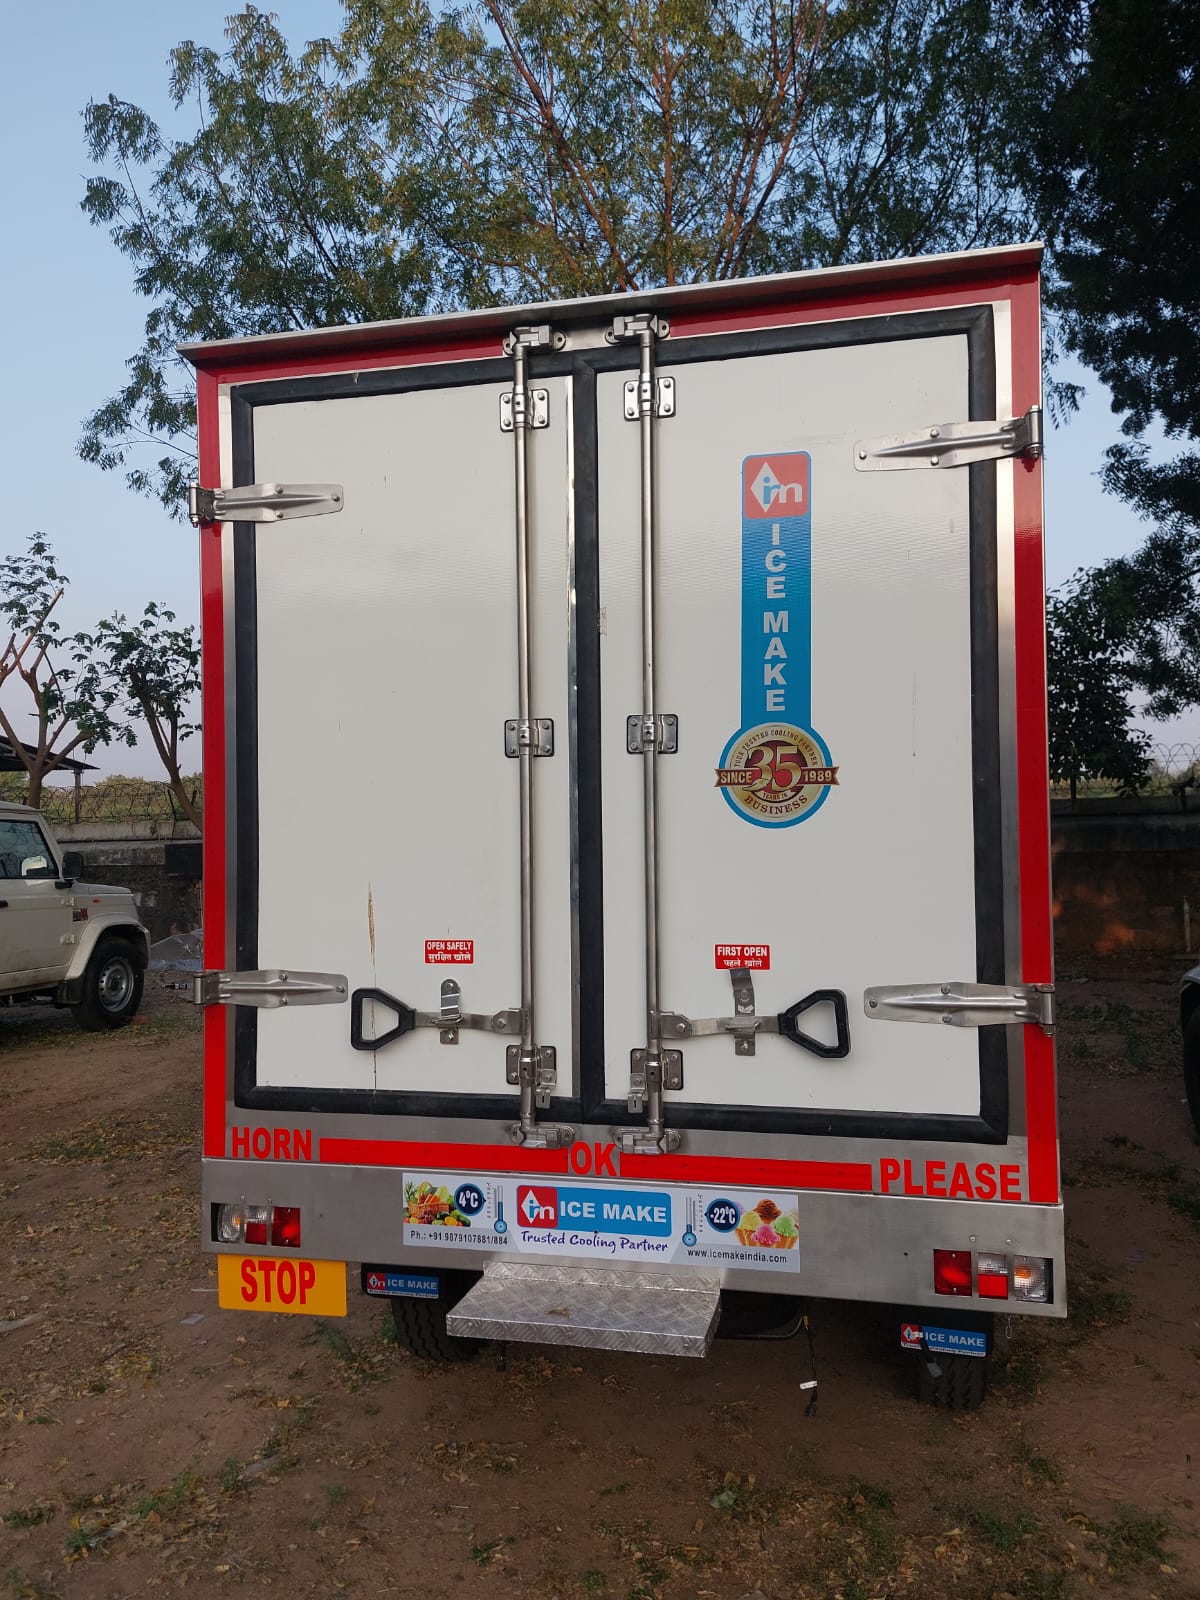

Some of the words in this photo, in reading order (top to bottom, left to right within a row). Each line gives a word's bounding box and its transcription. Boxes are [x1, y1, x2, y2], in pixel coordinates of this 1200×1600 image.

[765, 523, 786, 599] ICE
[763, 610, 789, 712] MAKE
[742, 730, 769, 750] TRUSTED
[770, 729, 799, 742] COOLING
[798, 738, 818, 766] PARTNER
[720, 772, 753, 783] SINCE
[803, 770, 833, 782] 1989
[742, 745, 802, 792] 35
[744, 794, 808, 815] BUSINESS
[427, 941, 445, 950] OPEN
[446, 941, 472, 950] SAFELY
[717, 946, 742, 956] FIRST
[743, 946, 768, 956] OPEN
[231, 1126, 312, 1161] HORN
[570, 1141, 618, 1177] OK
[879, 1157, 1022, 1201] PLEASE
[560, 1200, 595, 1218] ICE
[602, 1203, 667, 1223] MAKE
[428, 1231, 442, 1241] +91
[521, 1230, 565, 1245] Trusted
[569, 1233, 616, 1253] Cooling
[619, 1236, 668, 1252] Partner
[687, 1248, 788, 1264] www.icemakeindia.com
[240, 1258, 316, 1305] STOP
[387, 1279, 405, 1287] ICE
[407, 1280, 438, 1290] MAKE
[925, 1331, 945, 1342] ICE
[948, 1335, 985, 1347] MAKE
